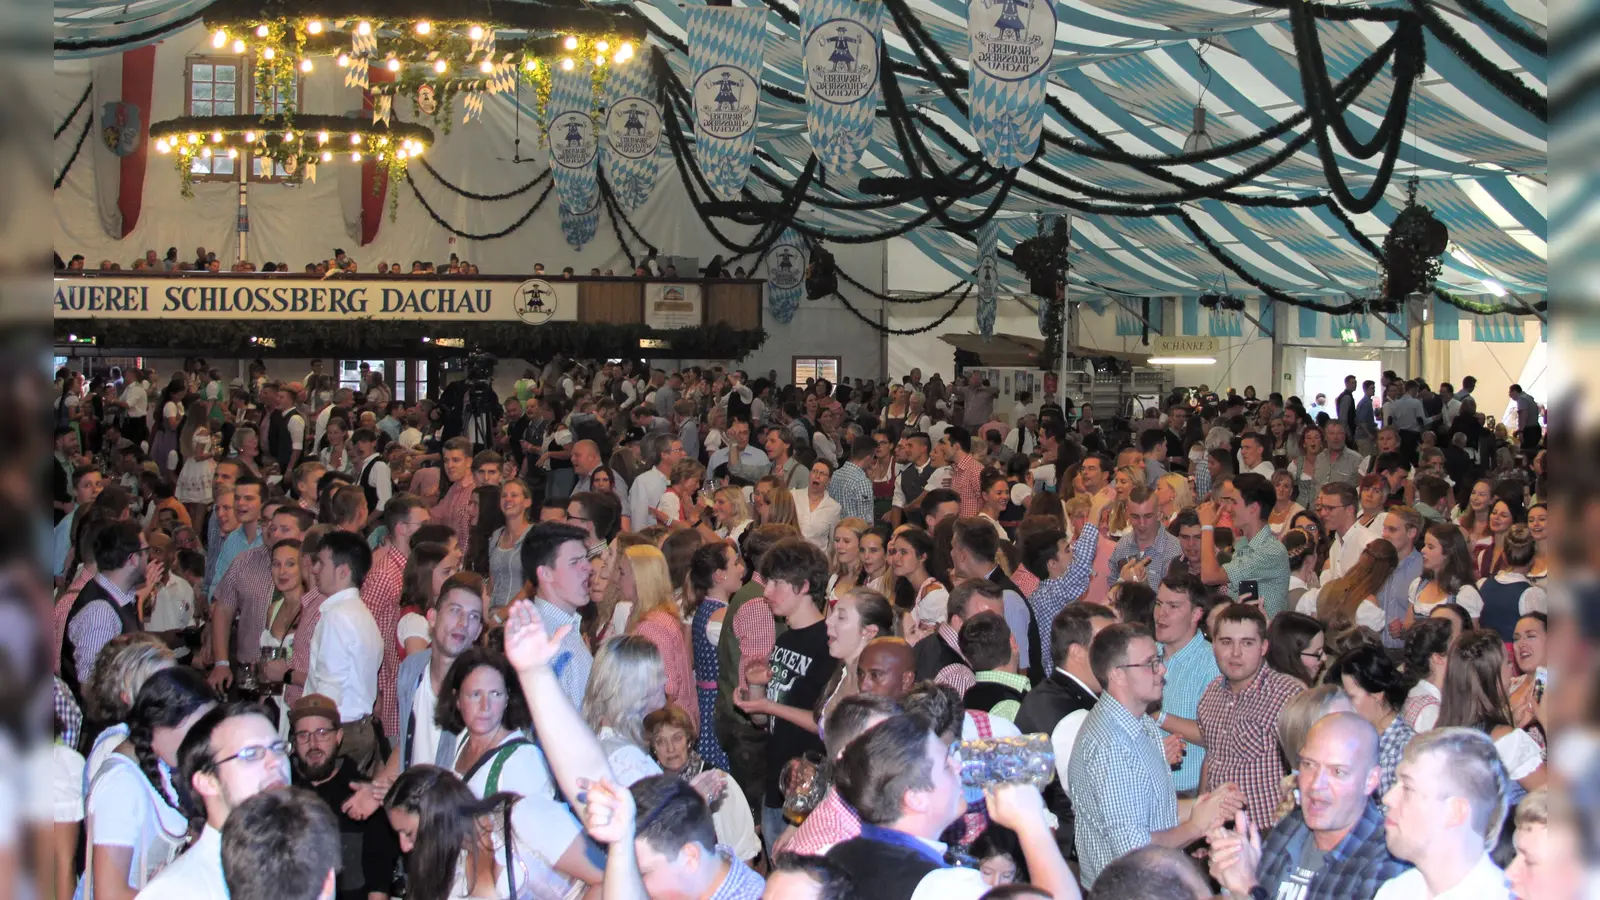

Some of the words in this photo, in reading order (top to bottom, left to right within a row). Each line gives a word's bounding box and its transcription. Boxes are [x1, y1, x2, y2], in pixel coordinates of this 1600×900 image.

[54, 286, 149, 311] AUEREI
[162, 286, 369, 315] SCHLOSSBERG
[379, 287, 493, 313] DACHAU
[1161, 340, 1205, 351] SCHÄNKE
[1207, 341, 1213, 350] 3
